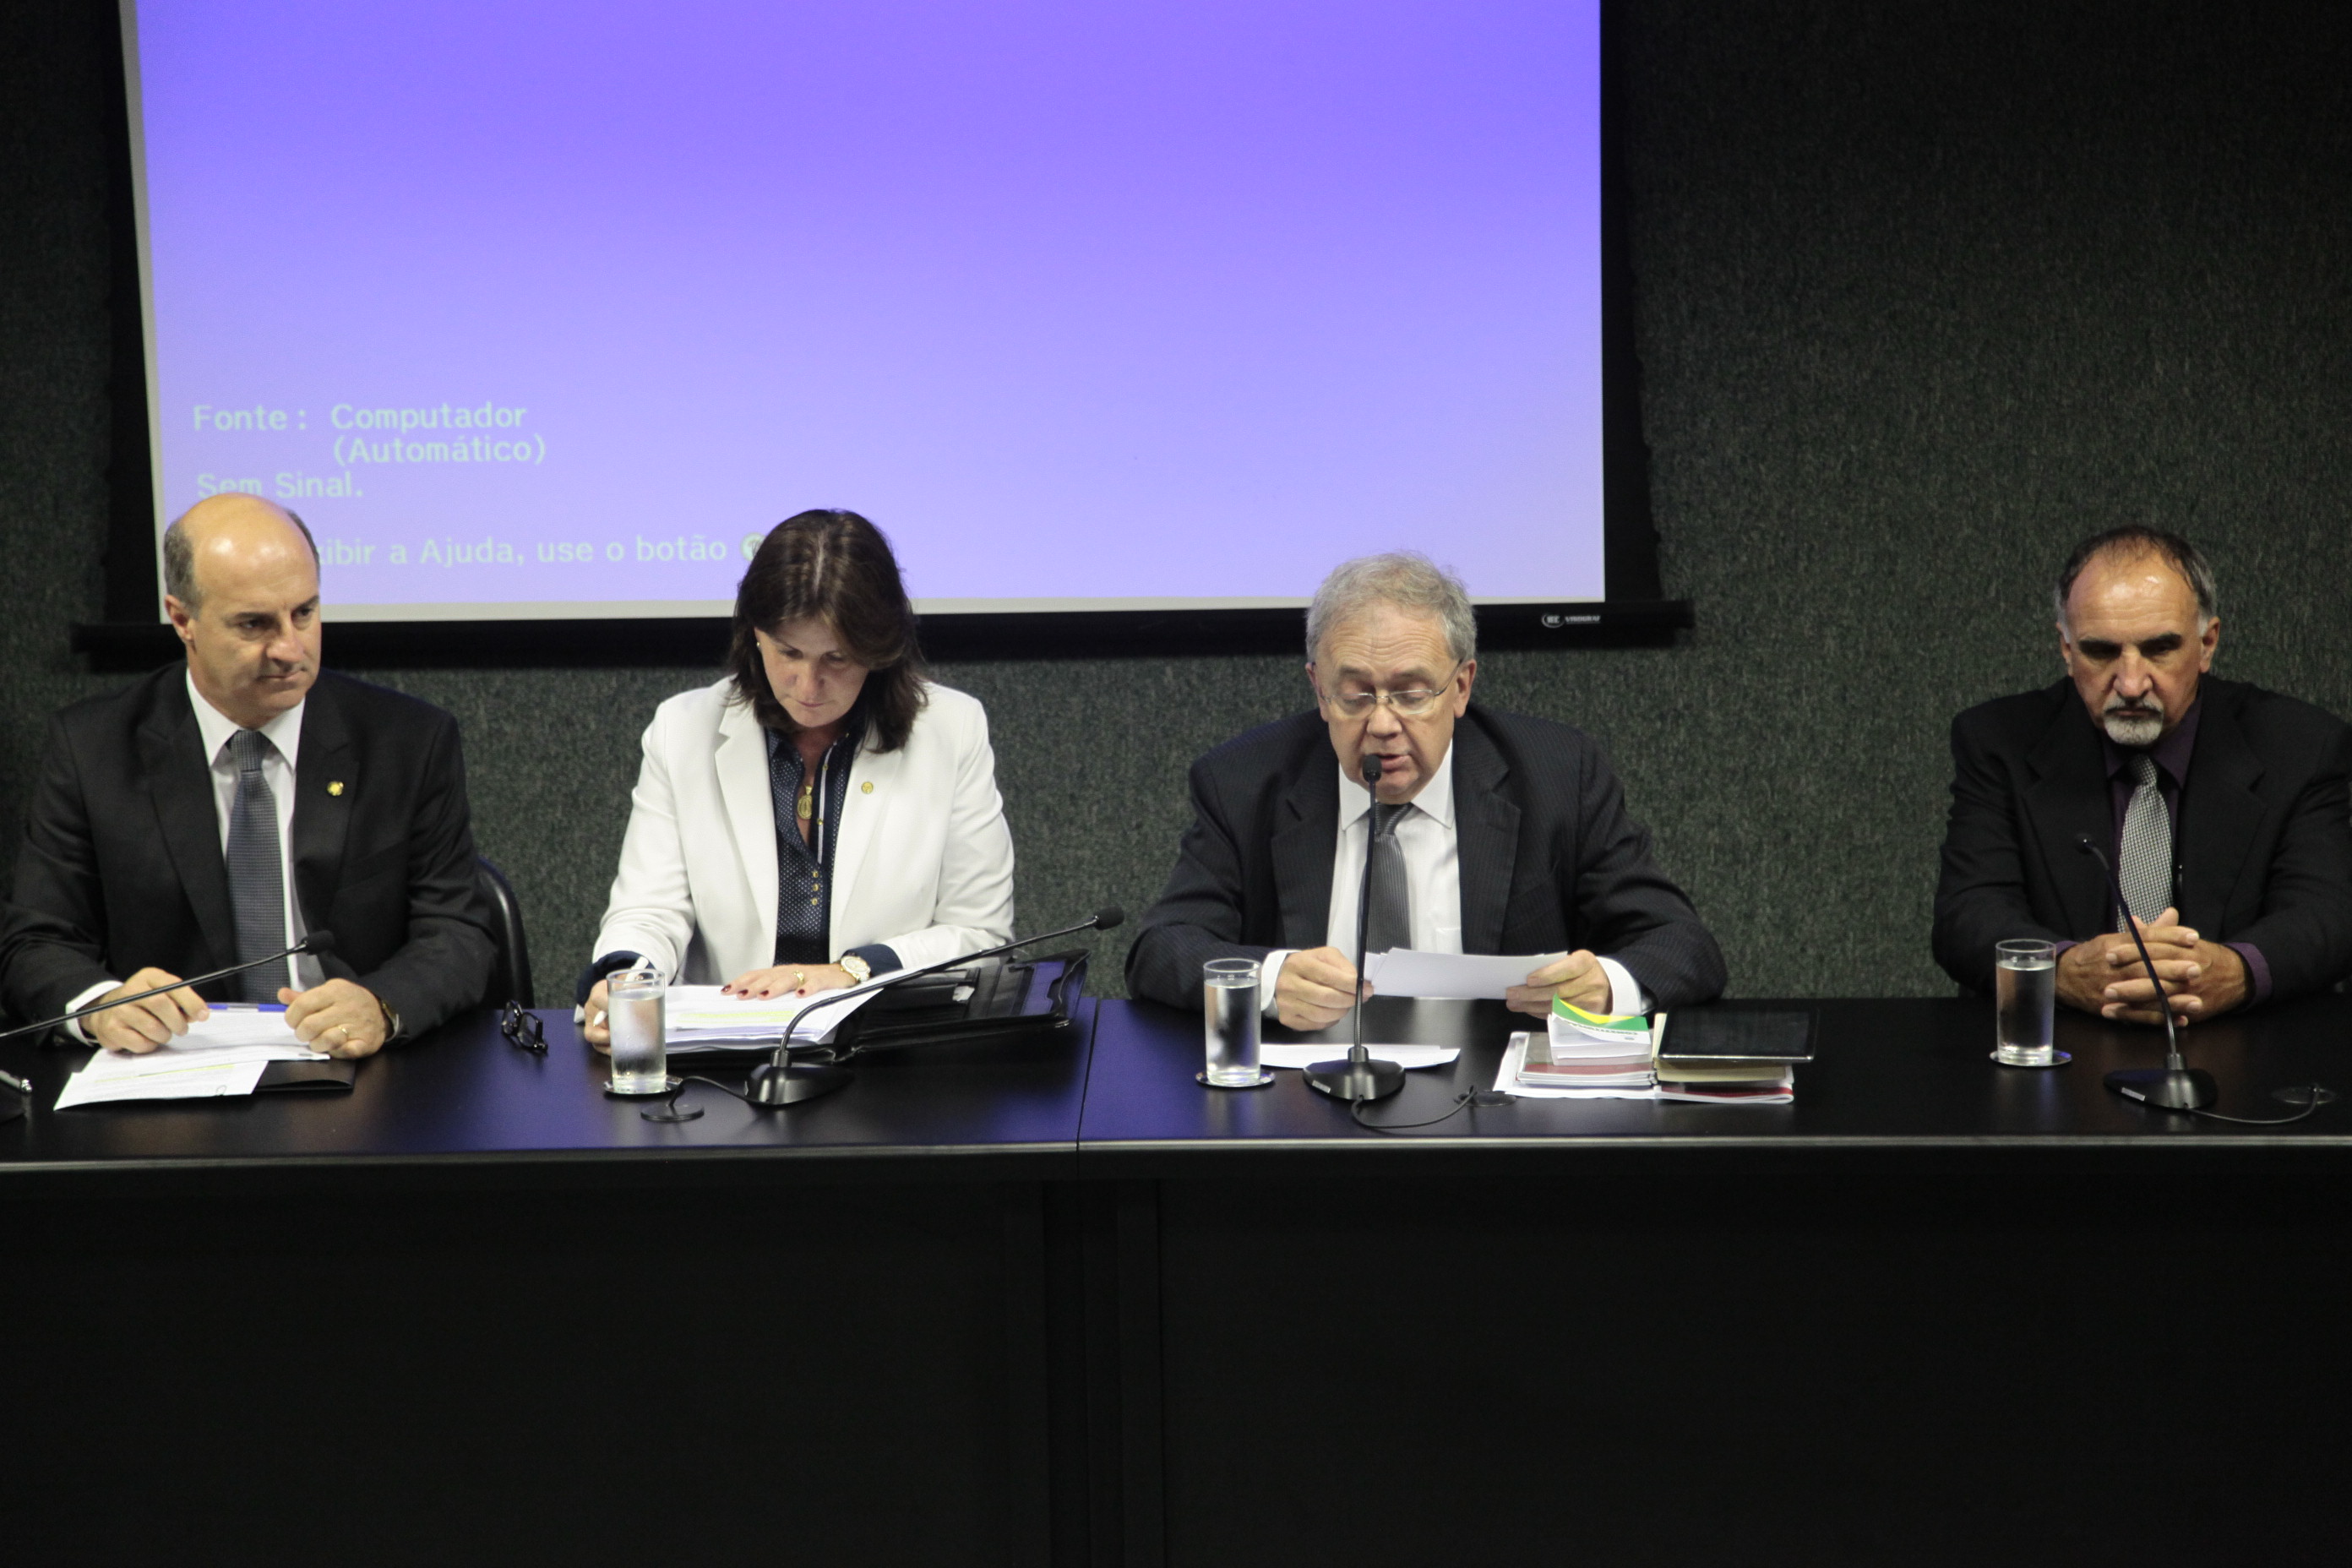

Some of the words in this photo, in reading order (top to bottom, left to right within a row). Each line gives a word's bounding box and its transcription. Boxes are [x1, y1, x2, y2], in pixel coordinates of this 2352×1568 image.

[330, 400, 527, 434] Computador
[334, 433, 546, 466] (Automático)
[197, 472, 262, 498] Sem
[275, 470, 363, 498] Sinal.
[389, 544, 407, 564] a
[420, 536, 525, 569] Ajuda,
[536, 542, 593, 563] use
[606, 542, 624, 562] o
[636, 534, 727, 562] botão
